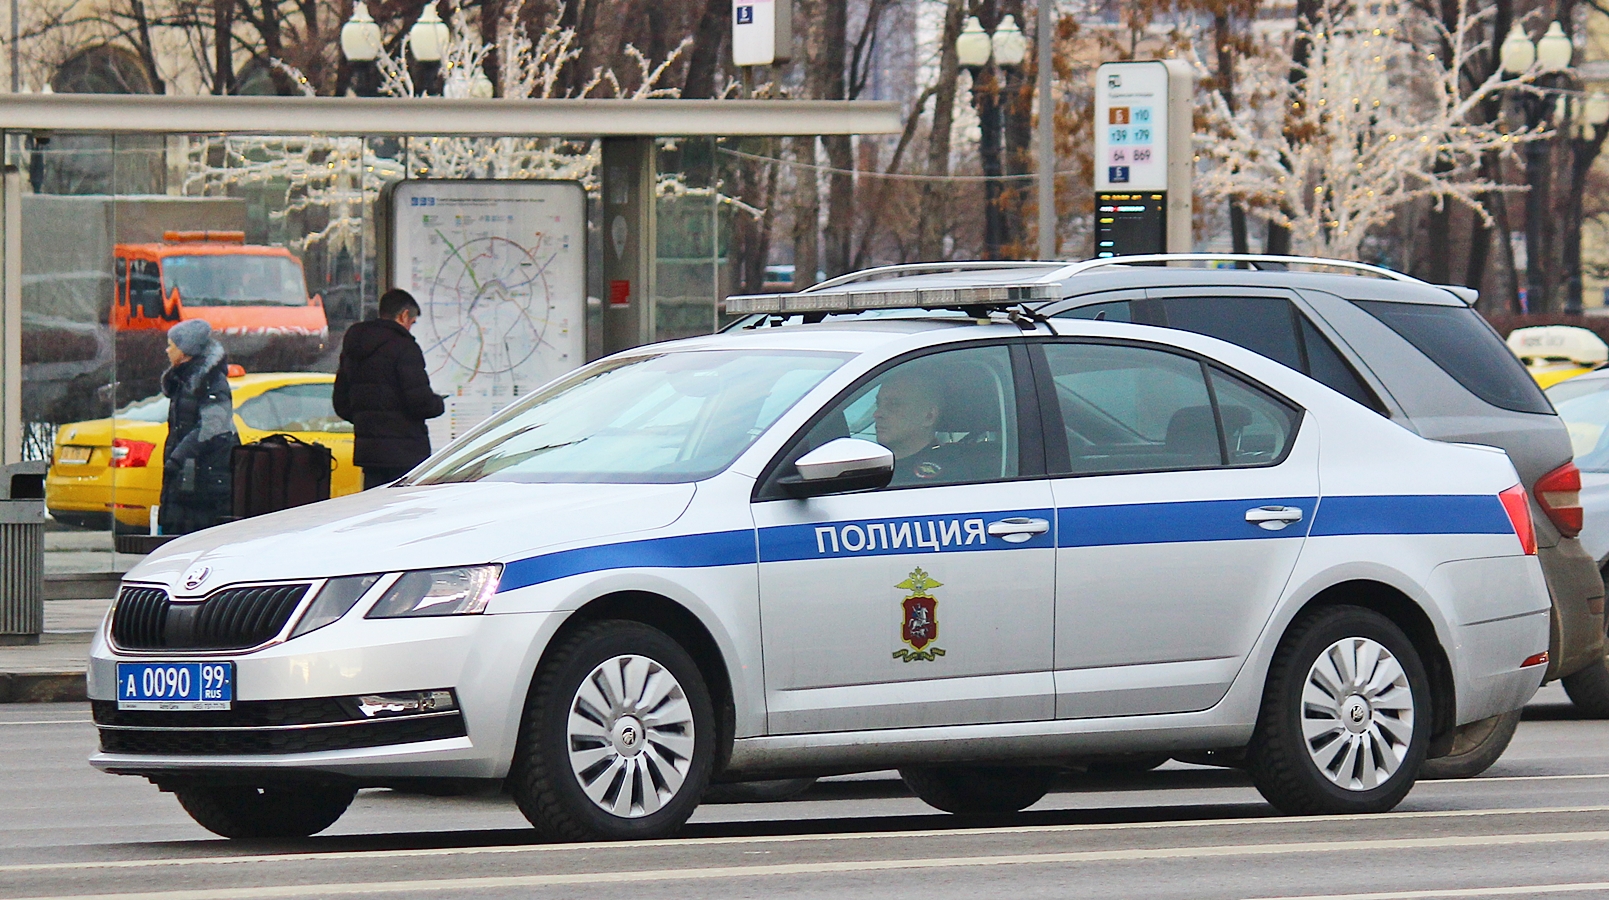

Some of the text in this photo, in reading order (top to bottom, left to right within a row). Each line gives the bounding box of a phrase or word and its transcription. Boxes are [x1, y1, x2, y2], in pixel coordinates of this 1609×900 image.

[815, 518, 987, 553] ПОЛИЦИЯ
[143, 667, 191, 698] 0090
[203, 665, 225, 689] 99
[205, 689, 222, 699] RUS
